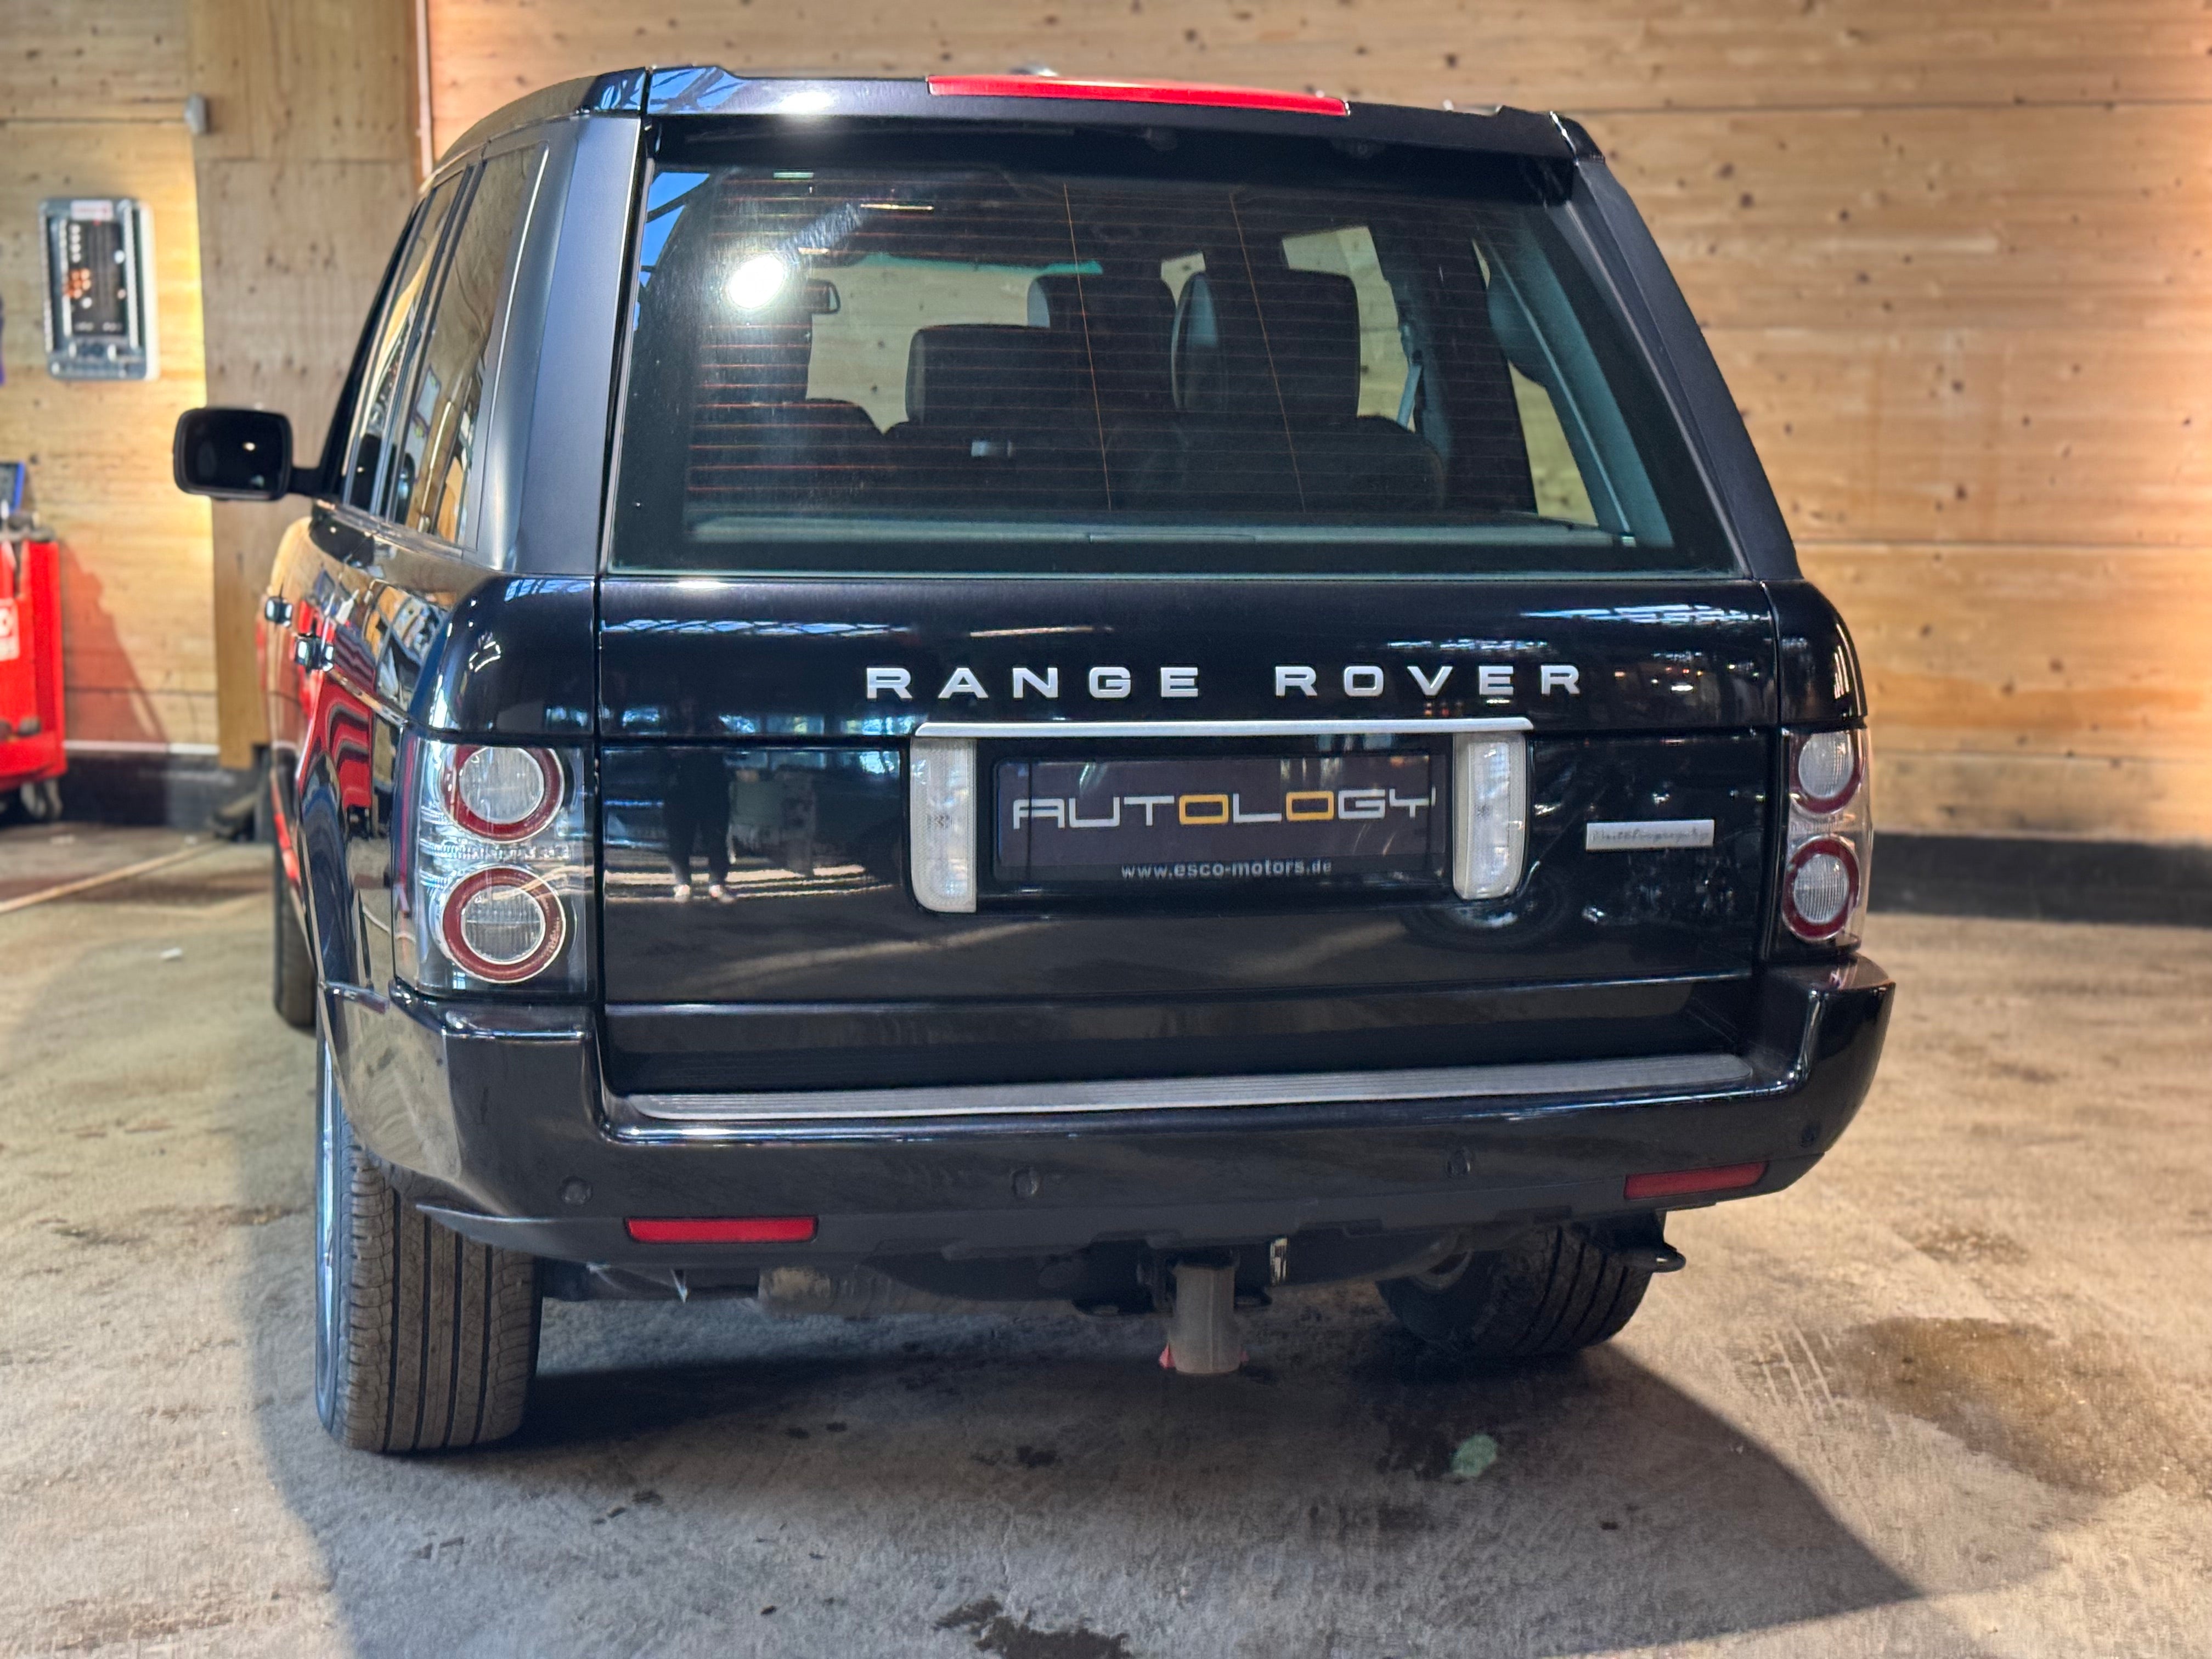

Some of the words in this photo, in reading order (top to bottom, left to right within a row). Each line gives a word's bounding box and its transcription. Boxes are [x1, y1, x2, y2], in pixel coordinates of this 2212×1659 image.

[866, 666, 1199, 699] RANGE
[1274, 664, 1581, 697] ROVER
[1013, 786, 1436, 829] AUTOLOGY
[1121, 858, 1332, 879] www.esco-motors.de
